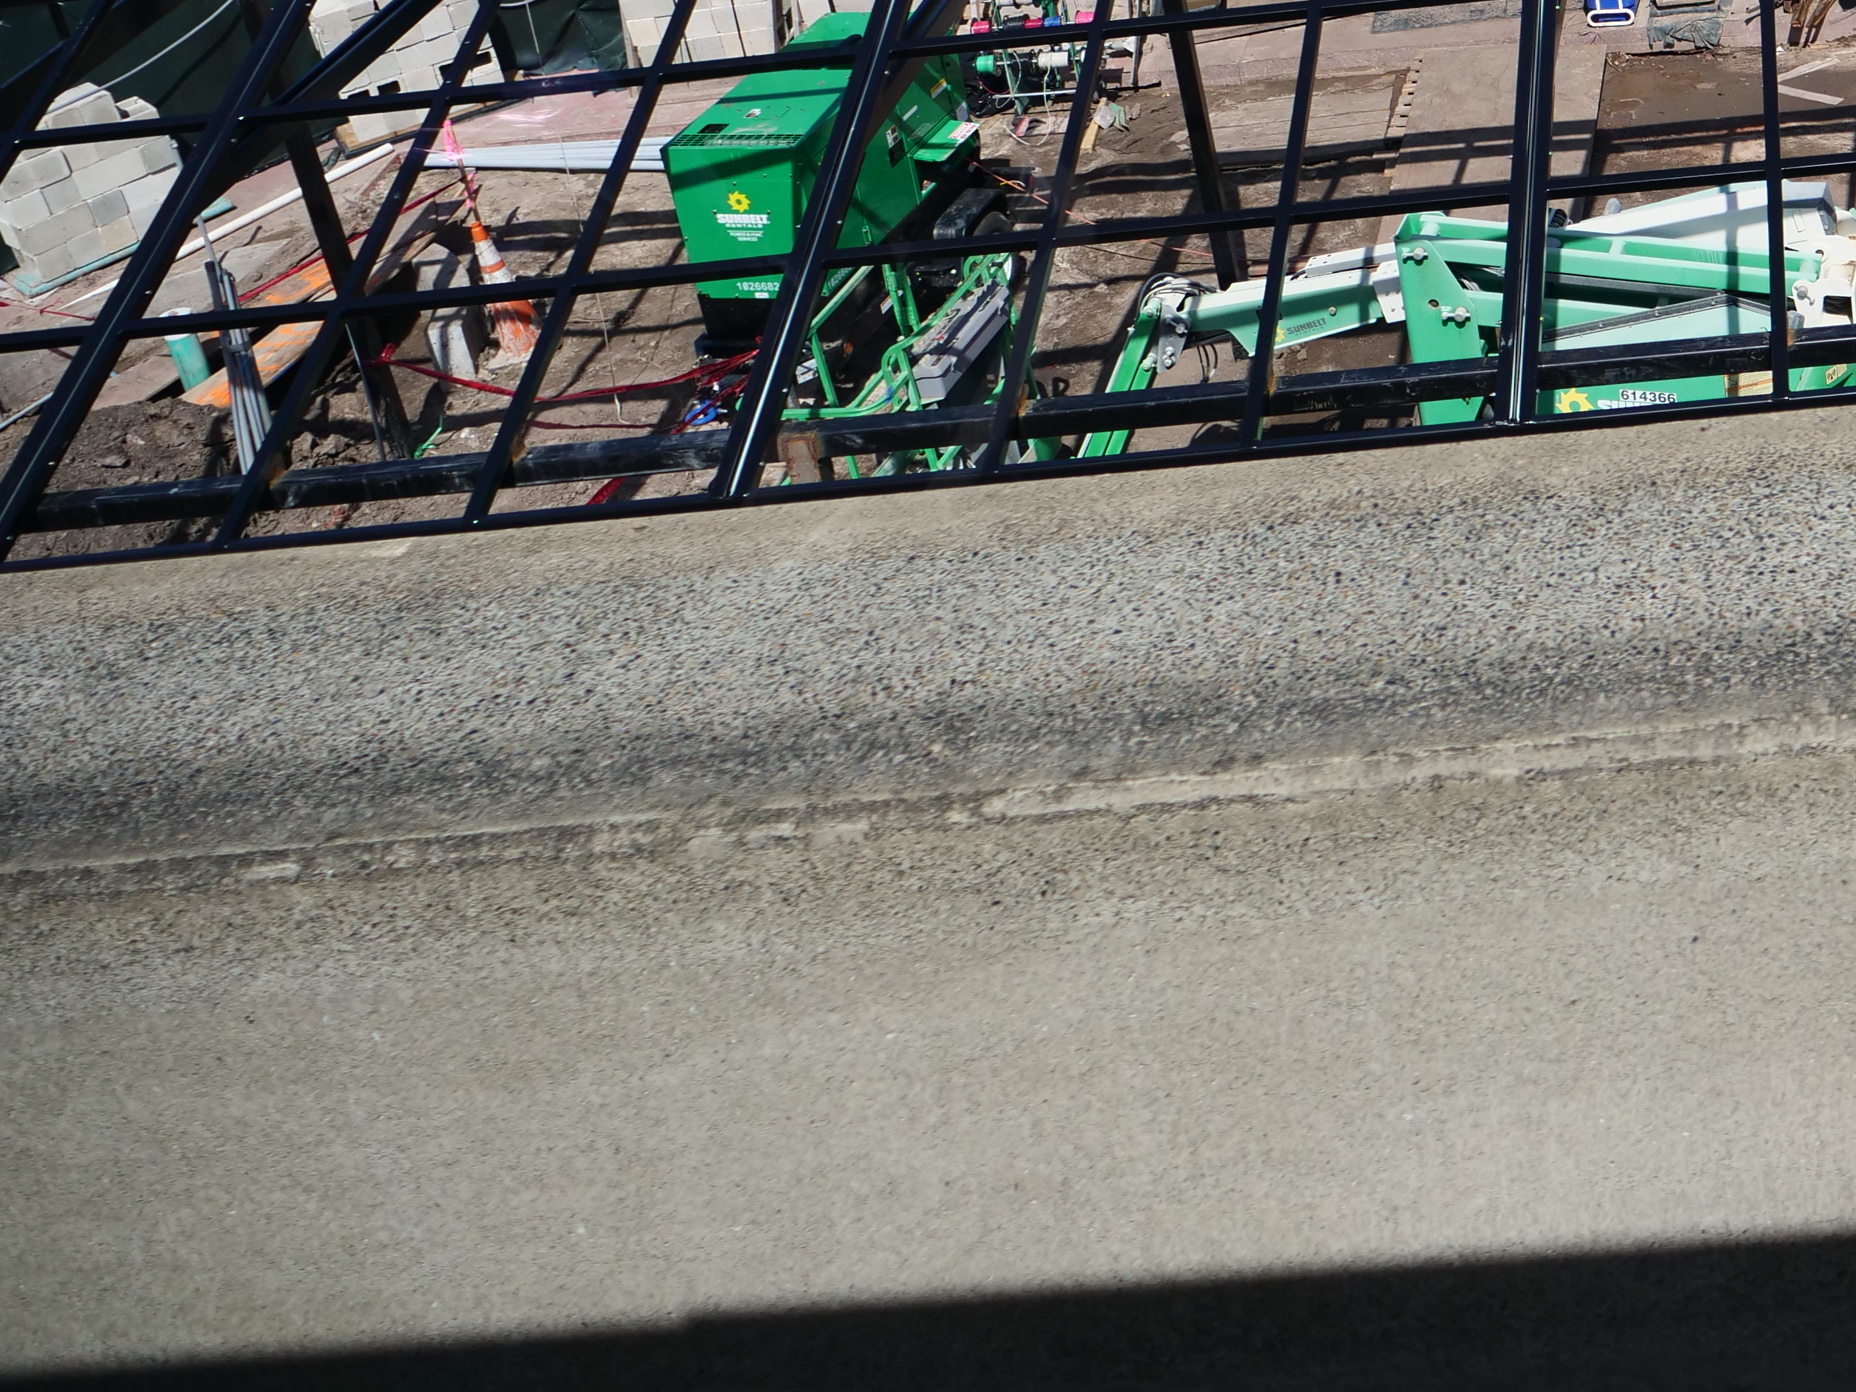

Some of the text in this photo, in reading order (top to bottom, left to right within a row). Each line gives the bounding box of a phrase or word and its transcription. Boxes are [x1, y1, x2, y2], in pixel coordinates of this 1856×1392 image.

[716, 213, 769, 224] SUNBELT
[736, 282, 780, 291] 1026682
[1287, 317, 1327, 335] SUNBELT
[1621, 390, 1677, 403] 614366
